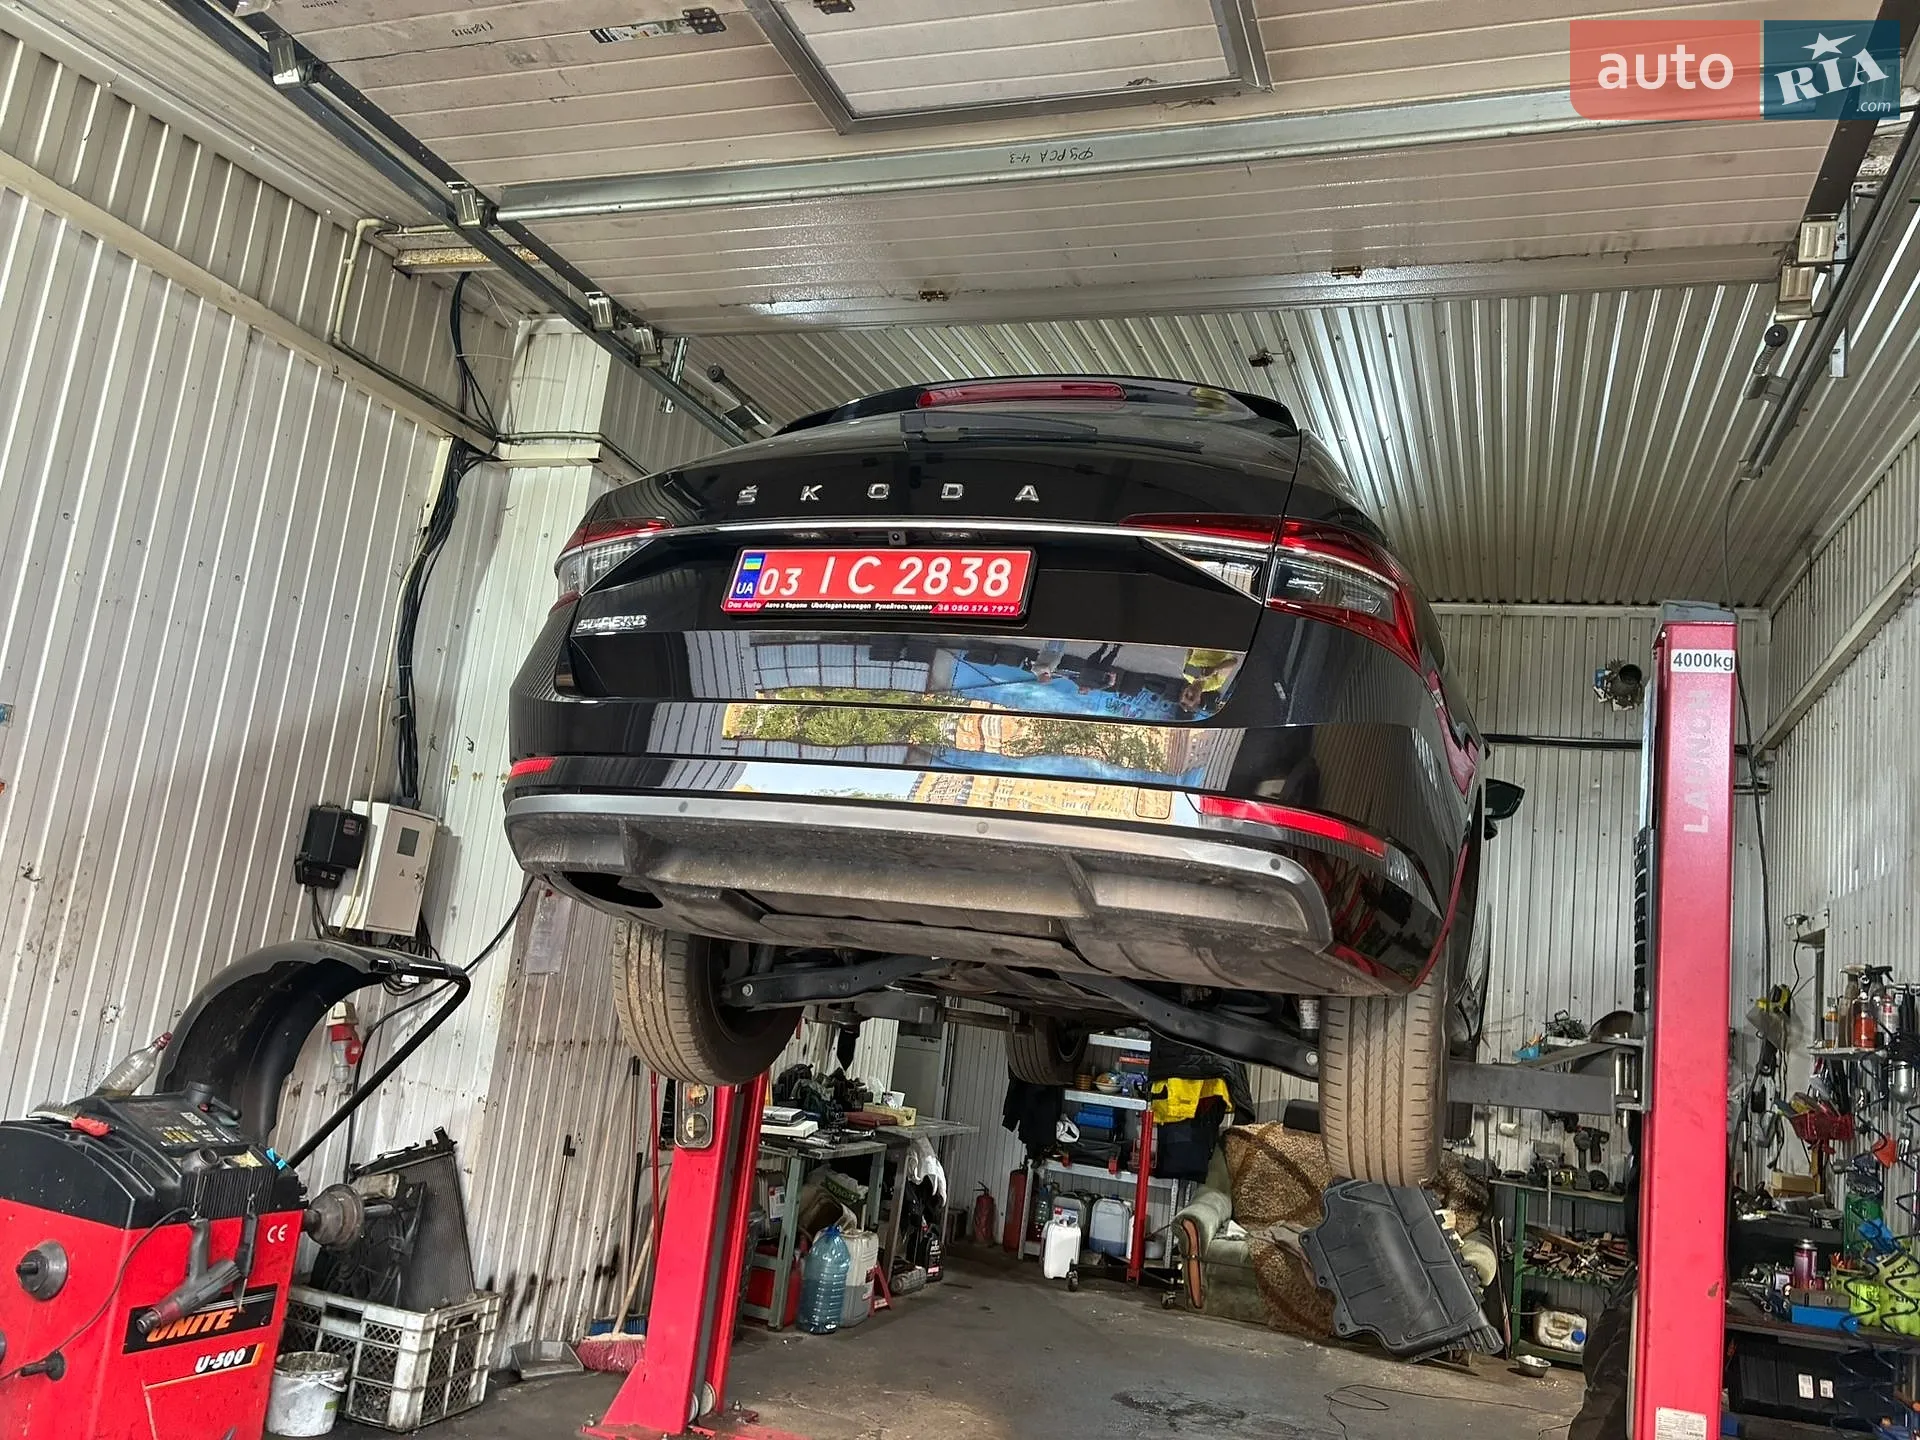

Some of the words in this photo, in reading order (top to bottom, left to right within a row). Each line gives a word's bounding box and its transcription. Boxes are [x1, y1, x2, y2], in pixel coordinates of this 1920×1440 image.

[736, 483, 1040, 505] ŠKODA
[736, 582, 754, 595] UA
[758, 567, 802, 596] 03
[892, 556, 1013, 597] 2838
[728, 601, 743, 609] Das
[744, 601, 761, 609] Auto
[1673, 652, 1734, 672] 4000kg
[146, 1307, 238, 1343] UNITE
[194, 1347, 246, 1374] U-500
